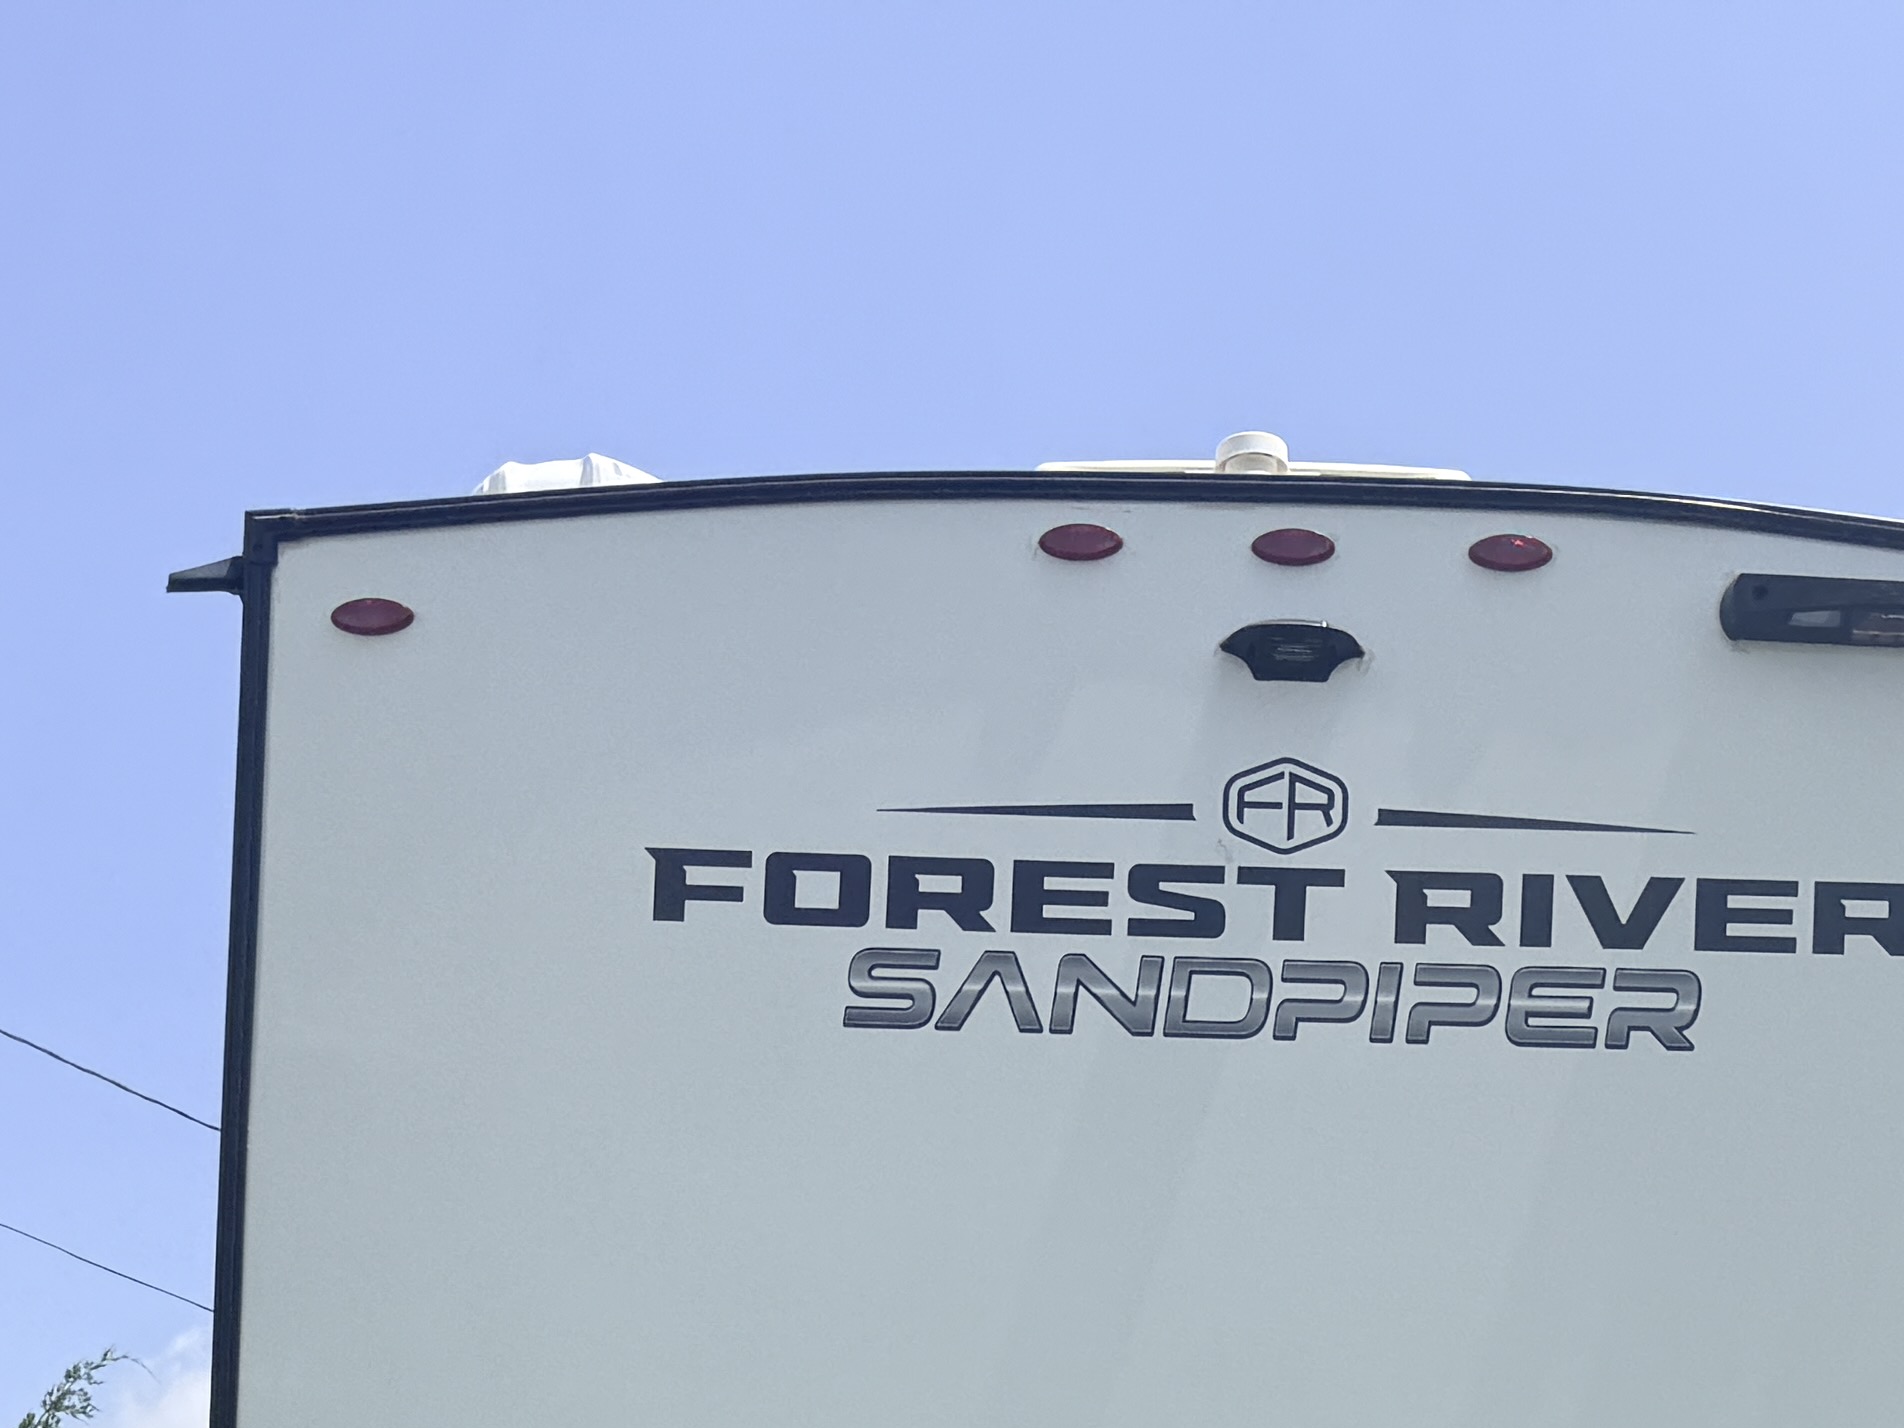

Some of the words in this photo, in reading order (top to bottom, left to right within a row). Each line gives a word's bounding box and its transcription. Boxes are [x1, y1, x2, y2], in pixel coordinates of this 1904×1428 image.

[1236, 770, 1336, 842] FR
[644, 846, 1346, 942] FOREST
[842, 946, 1703, 1052] SANDPIPER
